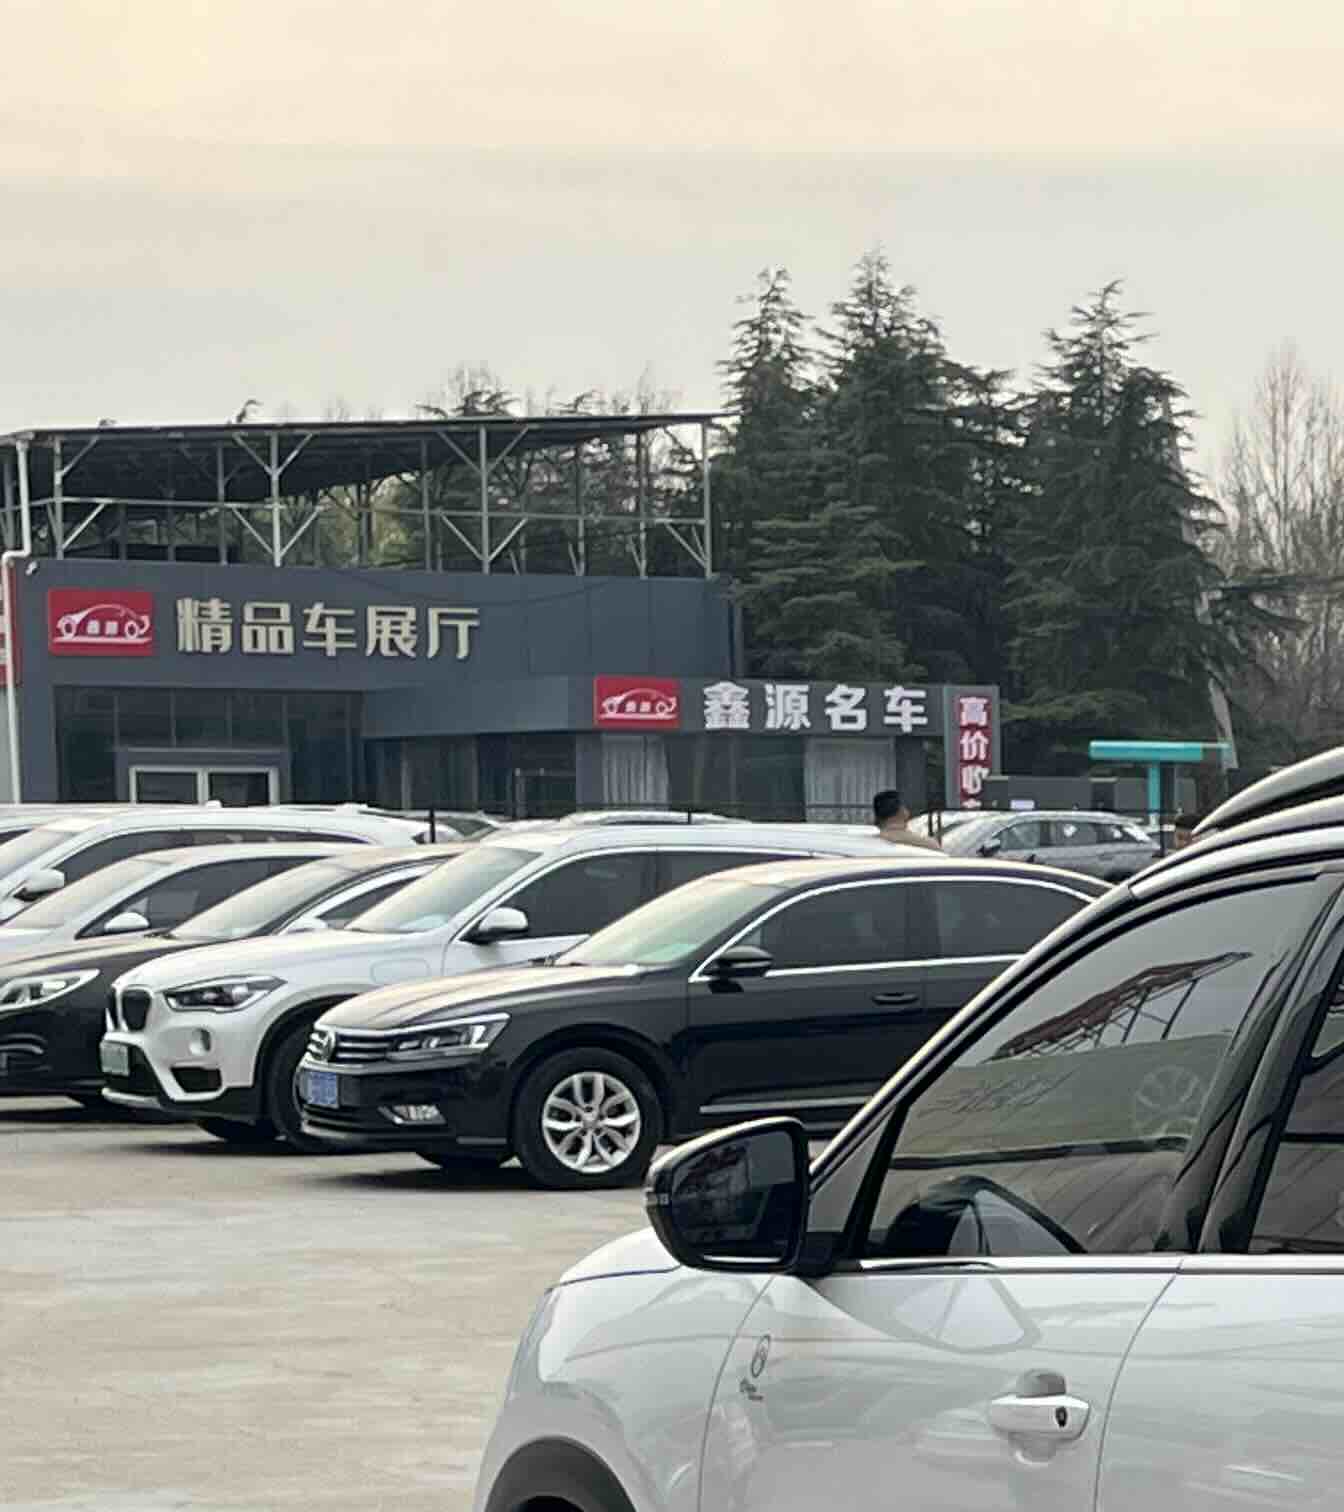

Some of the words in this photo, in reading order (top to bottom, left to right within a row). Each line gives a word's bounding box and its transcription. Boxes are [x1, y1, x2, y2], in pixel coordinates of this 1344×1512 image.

[175, 597, 481, 659] 精品车展厅
[703, 681, 929, 732] 鑫源名车
[959, 696, 990, 809] 高价收
